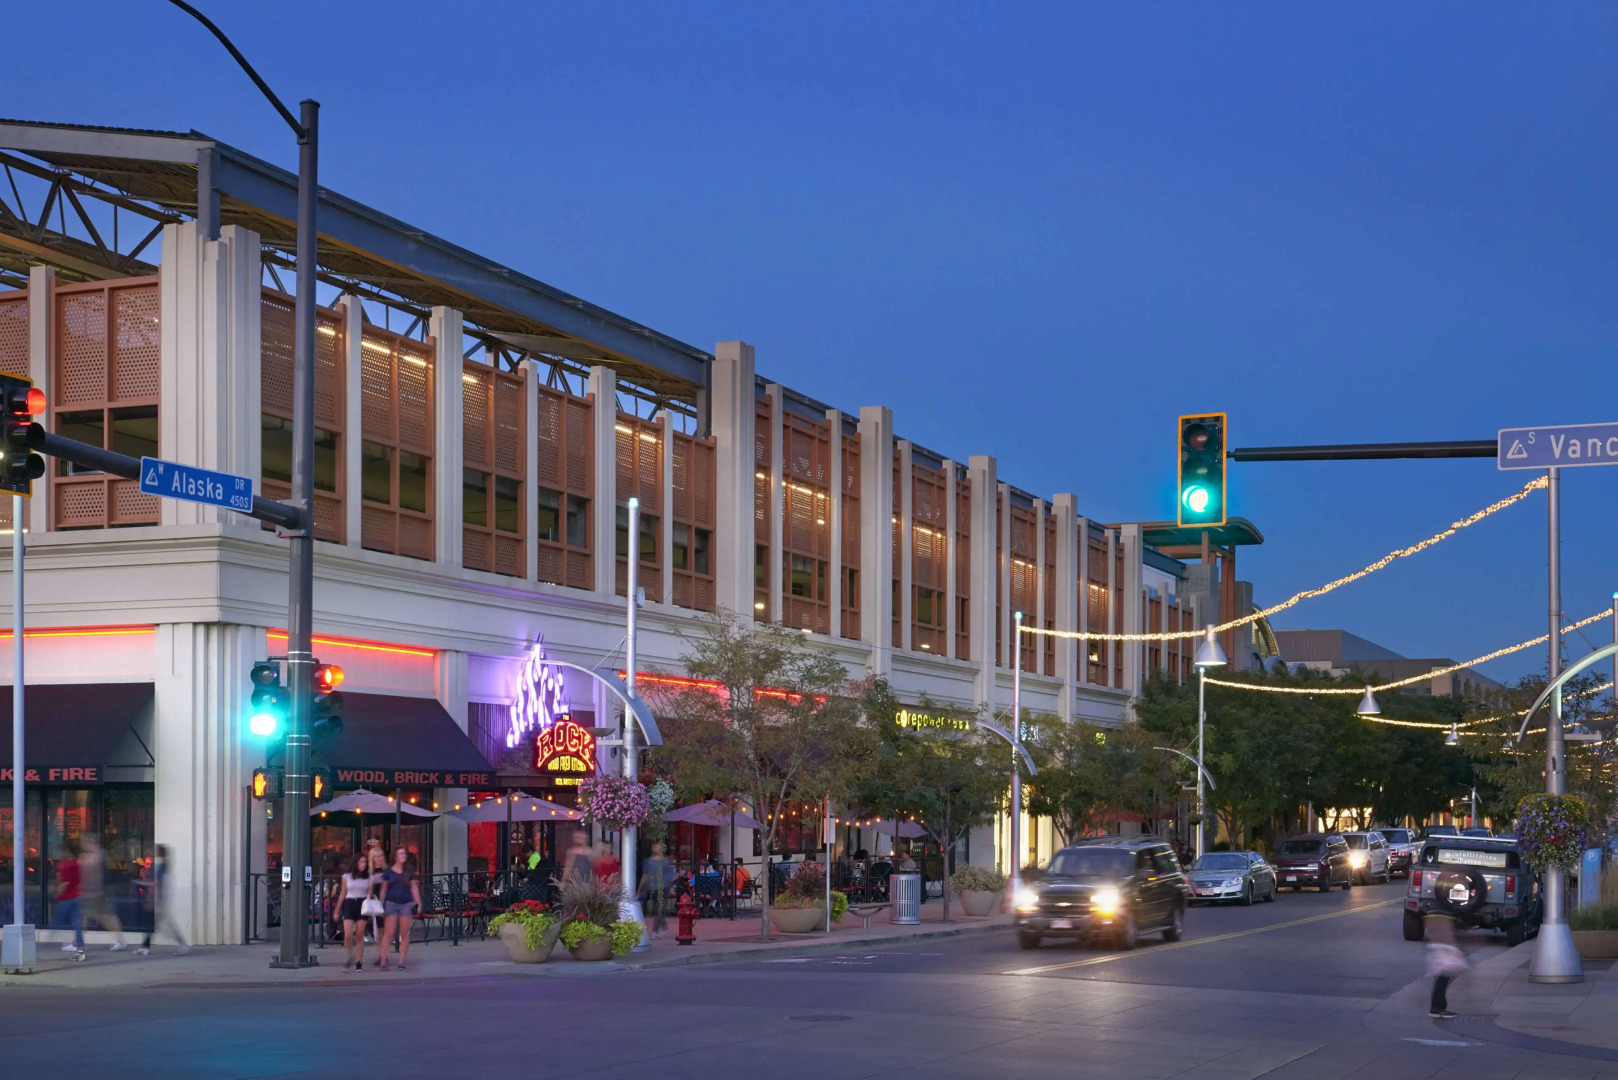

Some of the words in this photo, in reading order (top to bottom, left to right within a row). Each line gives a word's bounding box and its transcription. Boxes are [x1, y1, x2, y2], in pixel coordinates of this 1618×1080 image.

[1528, 432, 1536, 444] S
[158, 463, 164, 475] W
[172, 470, 223, 500] Alaska
[235, 478, 245, 490] DR
[230, 494, 249, 508] 450S
[536, 721, 595, 771] ROCK
[25, 769, 40, 781] &
[48, 767, 98, 781] FIRE
[337, 769, 389, 784] WOOD,
[394, 771, 439, 784] BRICK
[444, 773, 455, 785] &
[459, 773, 489, 785] FIRE
